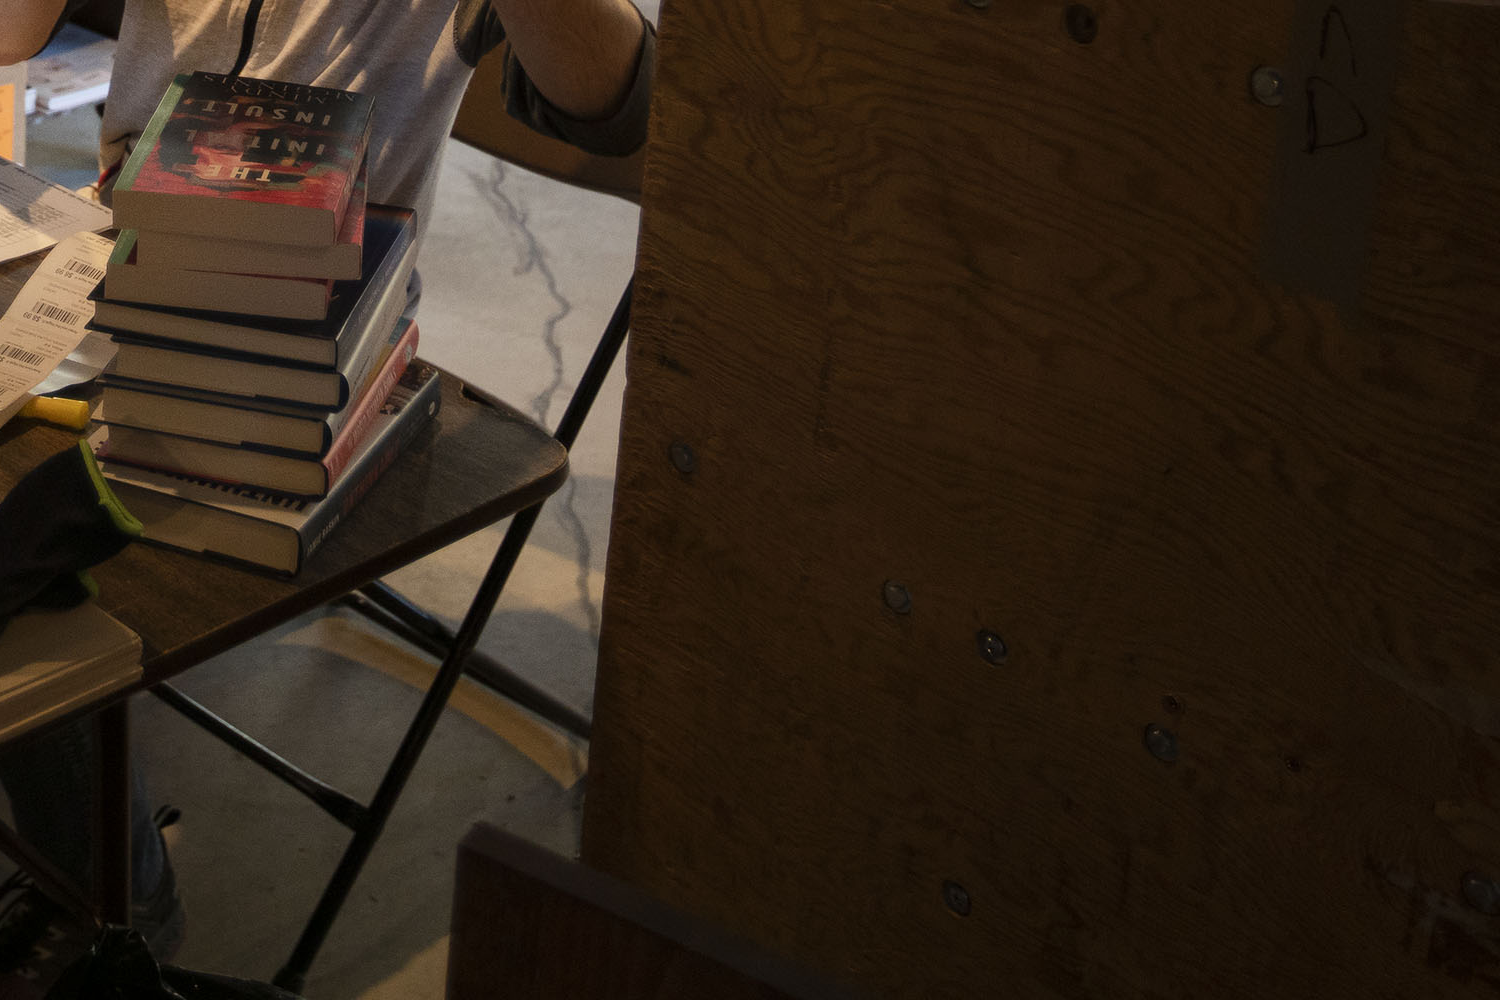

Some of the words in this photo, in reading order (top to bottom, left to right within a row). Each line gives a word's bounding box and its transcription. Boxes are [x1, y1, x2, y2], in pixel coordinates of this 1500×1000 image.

[200, 99, 332, 127] INSULT
[184, 128, 326, 157] INITL
[207, 163, 273, 183] THE
